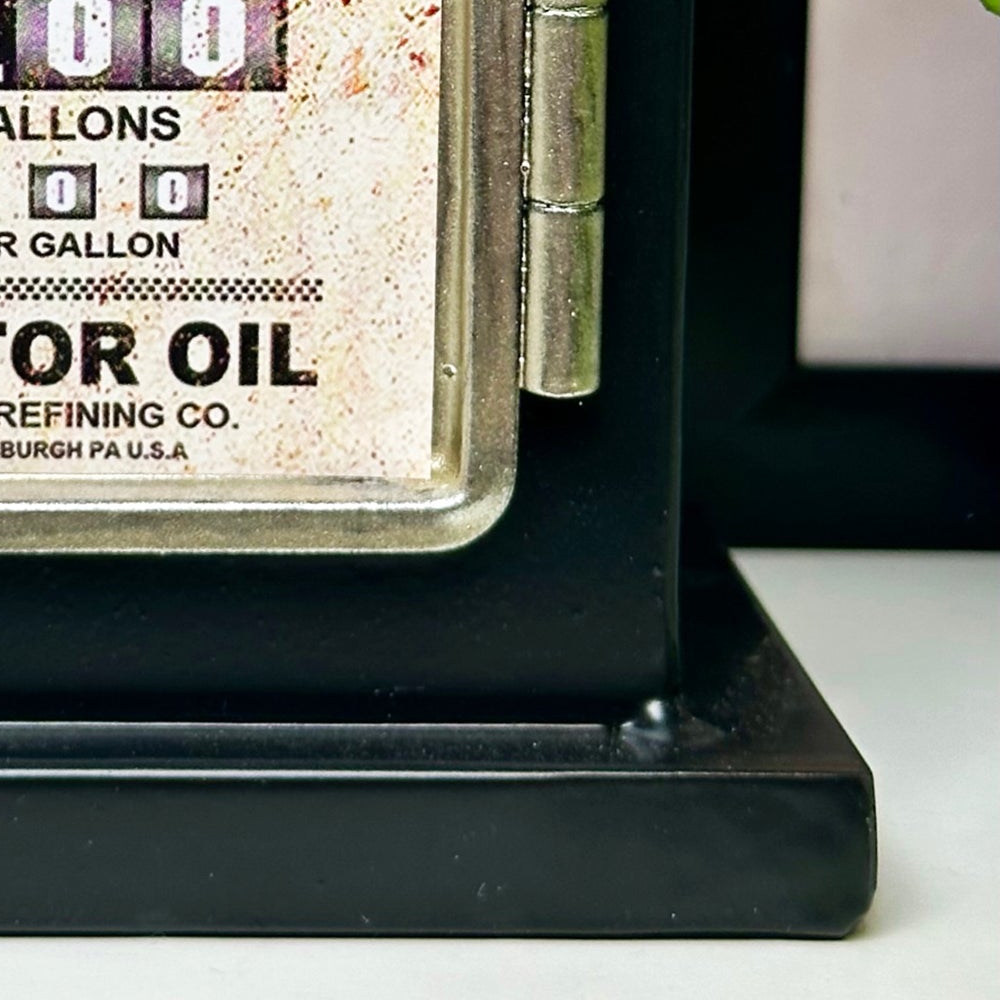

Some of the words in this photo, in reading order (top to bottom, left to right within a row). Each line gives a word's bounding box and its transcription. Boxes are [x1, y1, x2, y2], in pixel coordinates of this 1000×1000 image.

[29, 231, 180, 259] GALLON
[168, 321, 319, 388] OIL
[176, 402, 240, 430] CO.
[89, 441, 121, 460] PA
[127, 441, 188, 460] U.S.A
